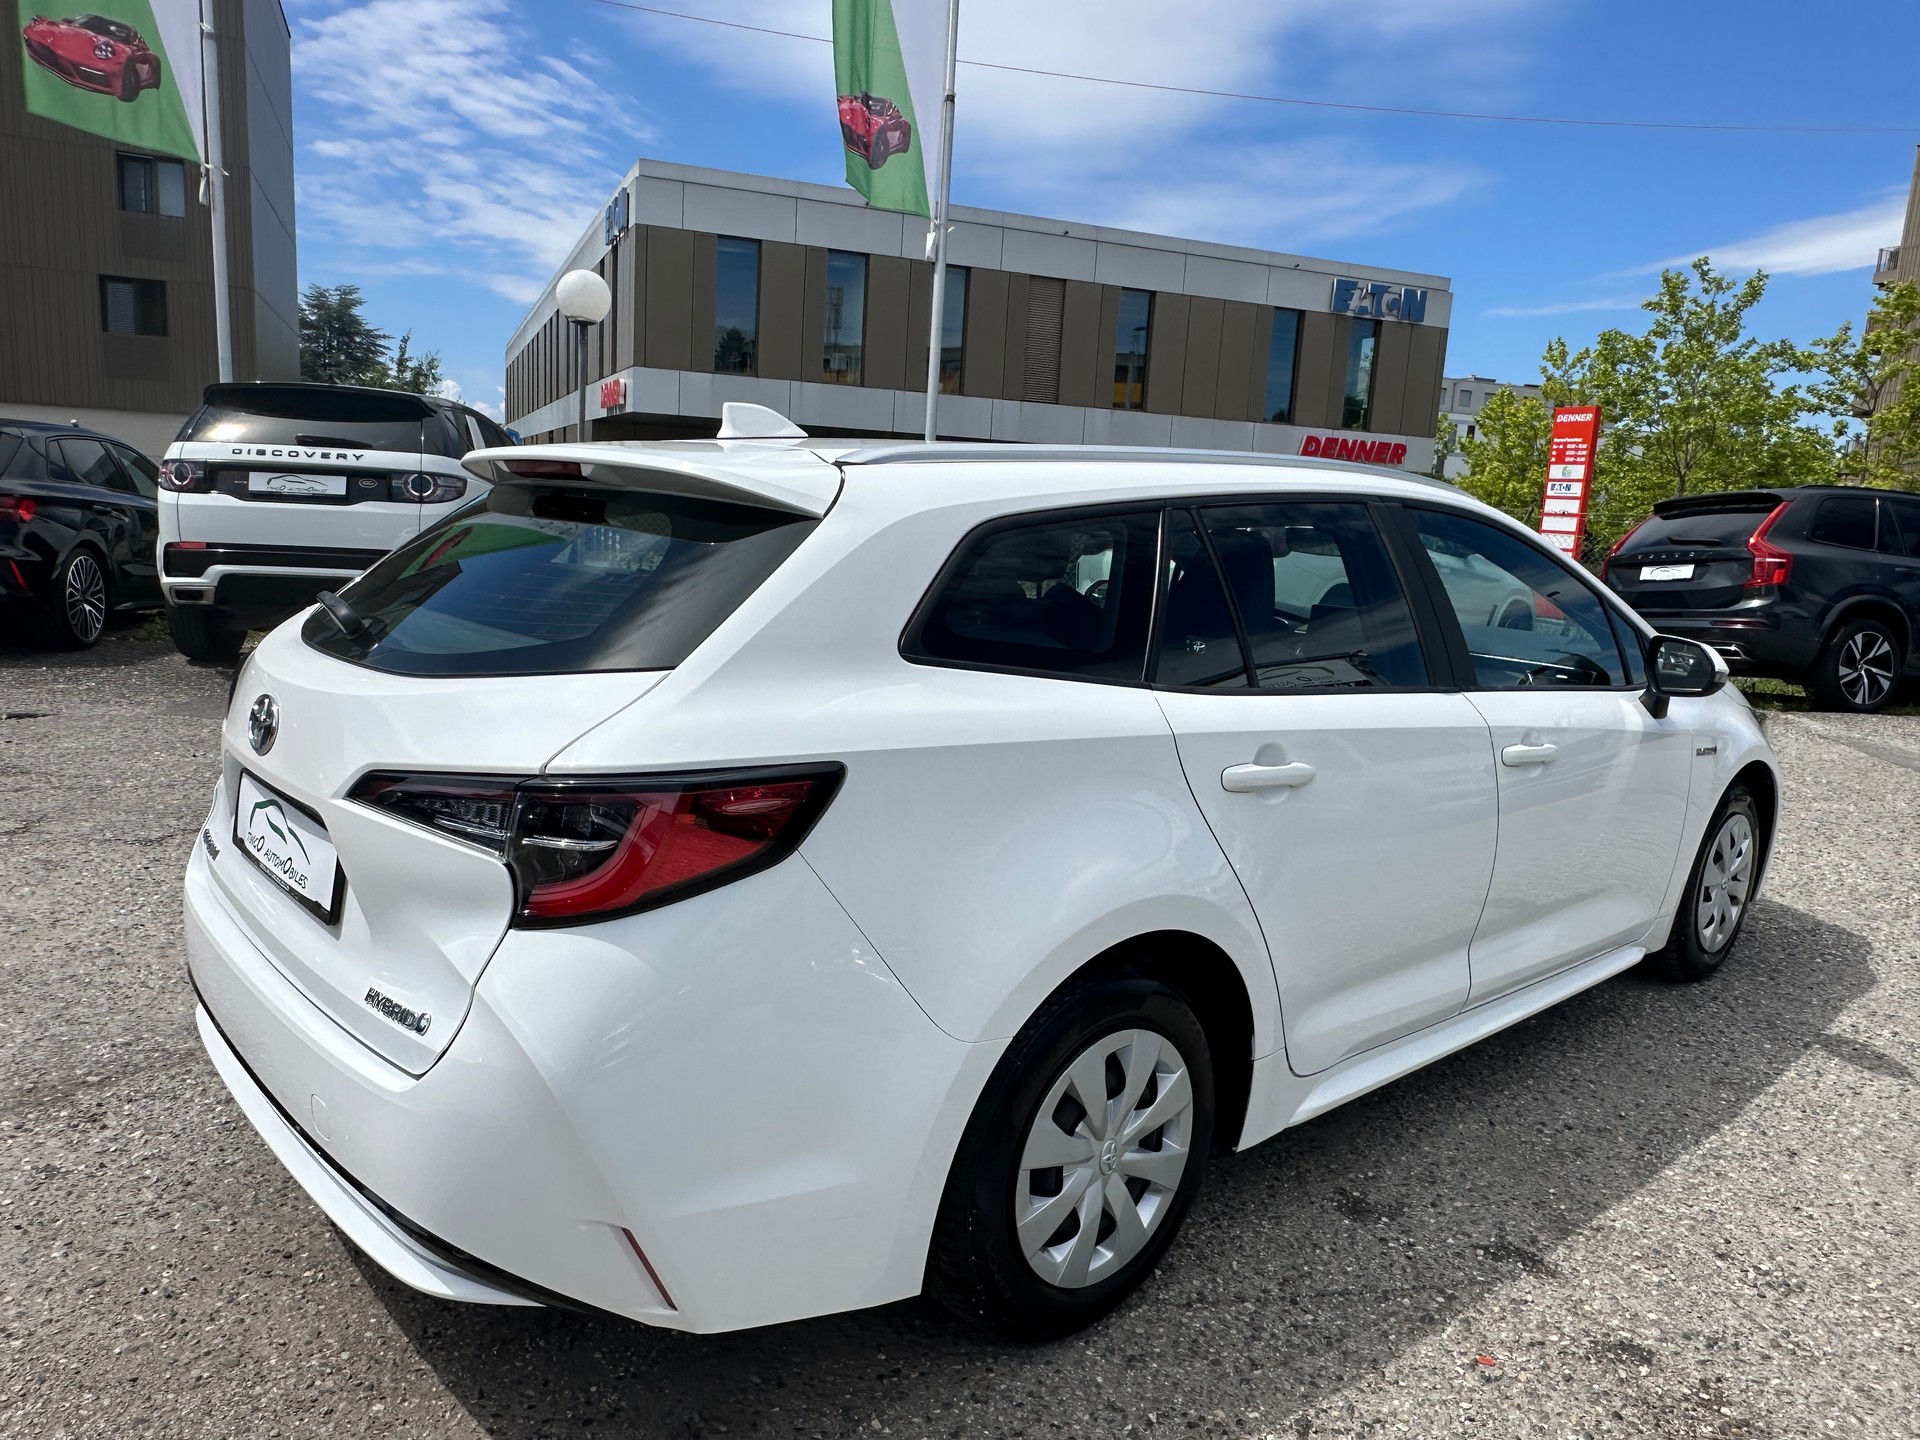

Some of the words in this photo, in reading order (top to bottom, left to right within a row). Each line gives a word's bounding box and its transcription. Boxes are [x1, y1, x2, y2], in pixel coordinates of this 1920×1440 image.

[1331, 278, 1428, 323] EATON
[1556, 413, 1593, 423] DENNER
[232, 448, 364, 461] DISCOVERY
[1298, 435, 1407, 465] DENNER
[263, 848, 309, 889] AUTOMOBILES
[364, 986, 419, 1032] HYBRID
